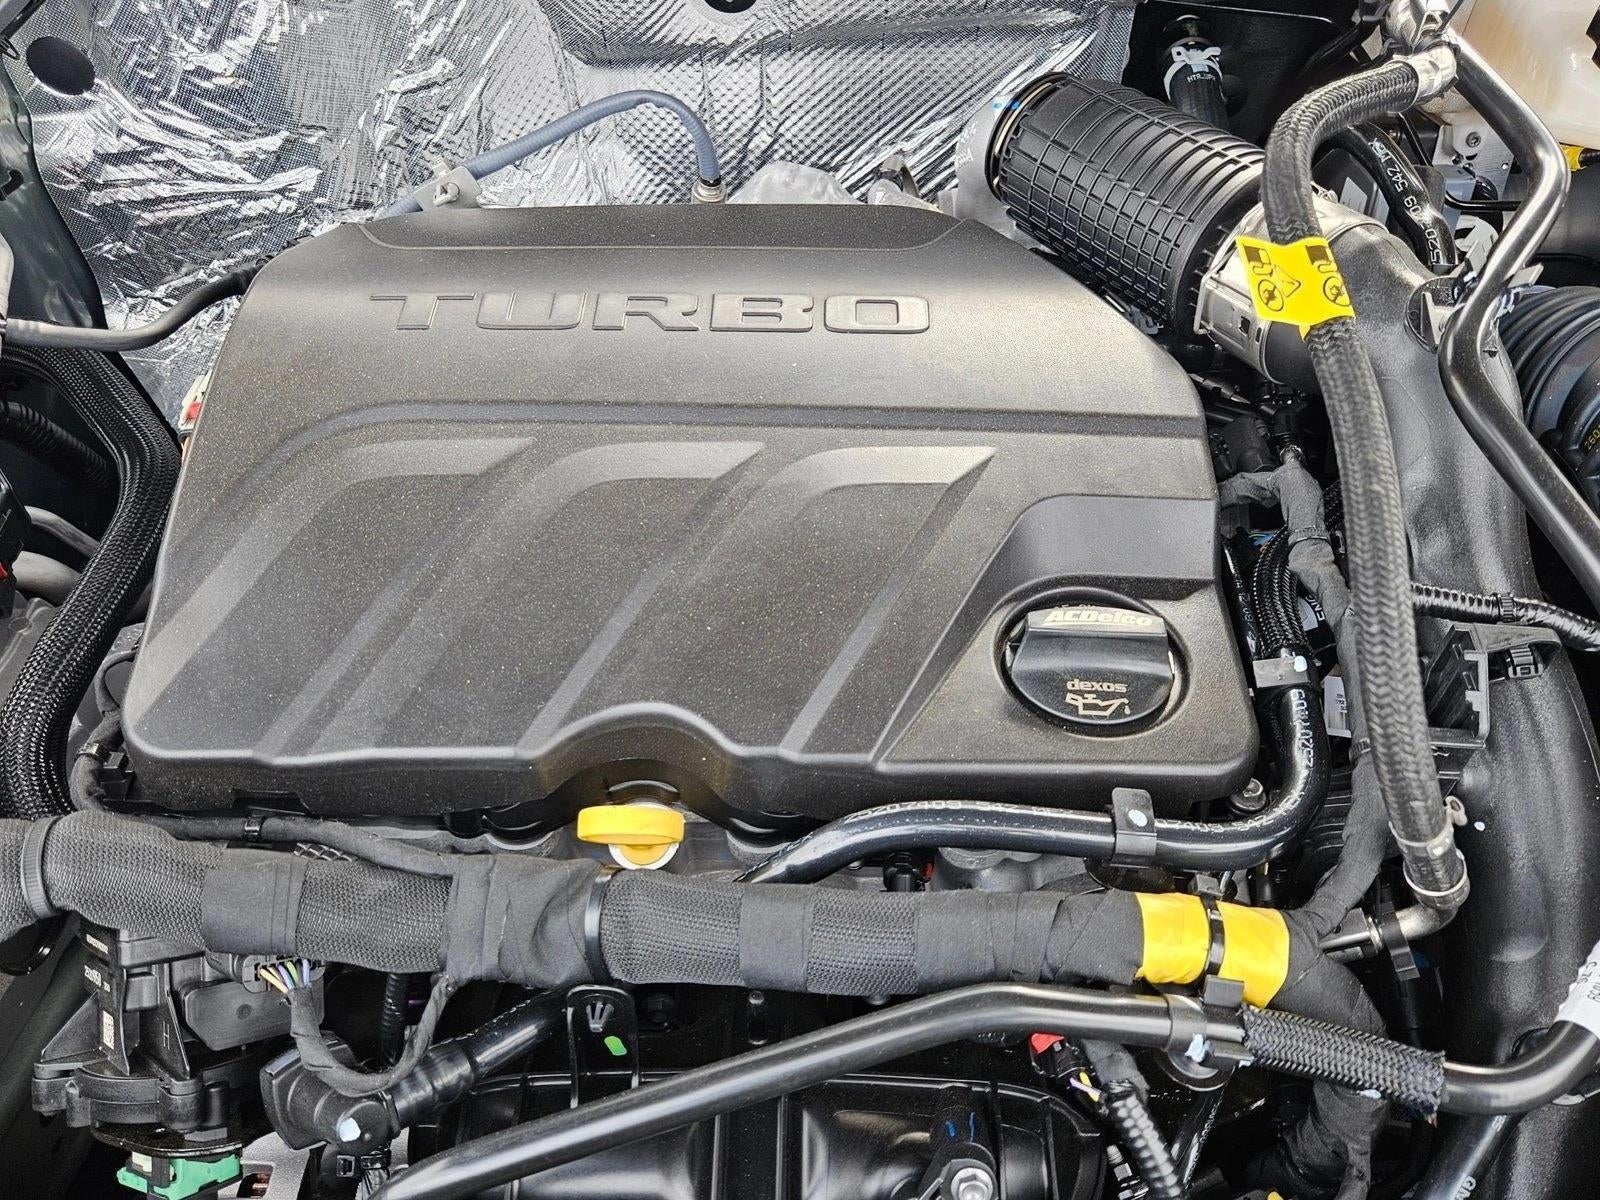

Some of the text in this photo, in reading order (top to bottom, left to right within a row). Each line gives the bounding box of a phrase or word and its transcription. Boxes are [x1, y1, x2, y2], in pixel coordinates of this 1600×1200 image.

[1387, 164, 1409, 192] 542
[370, 291, 930, 334] TURBO
[1044, 609, 1153, 626] ACDelco
[1066, 678, 1128, 693] dexos
